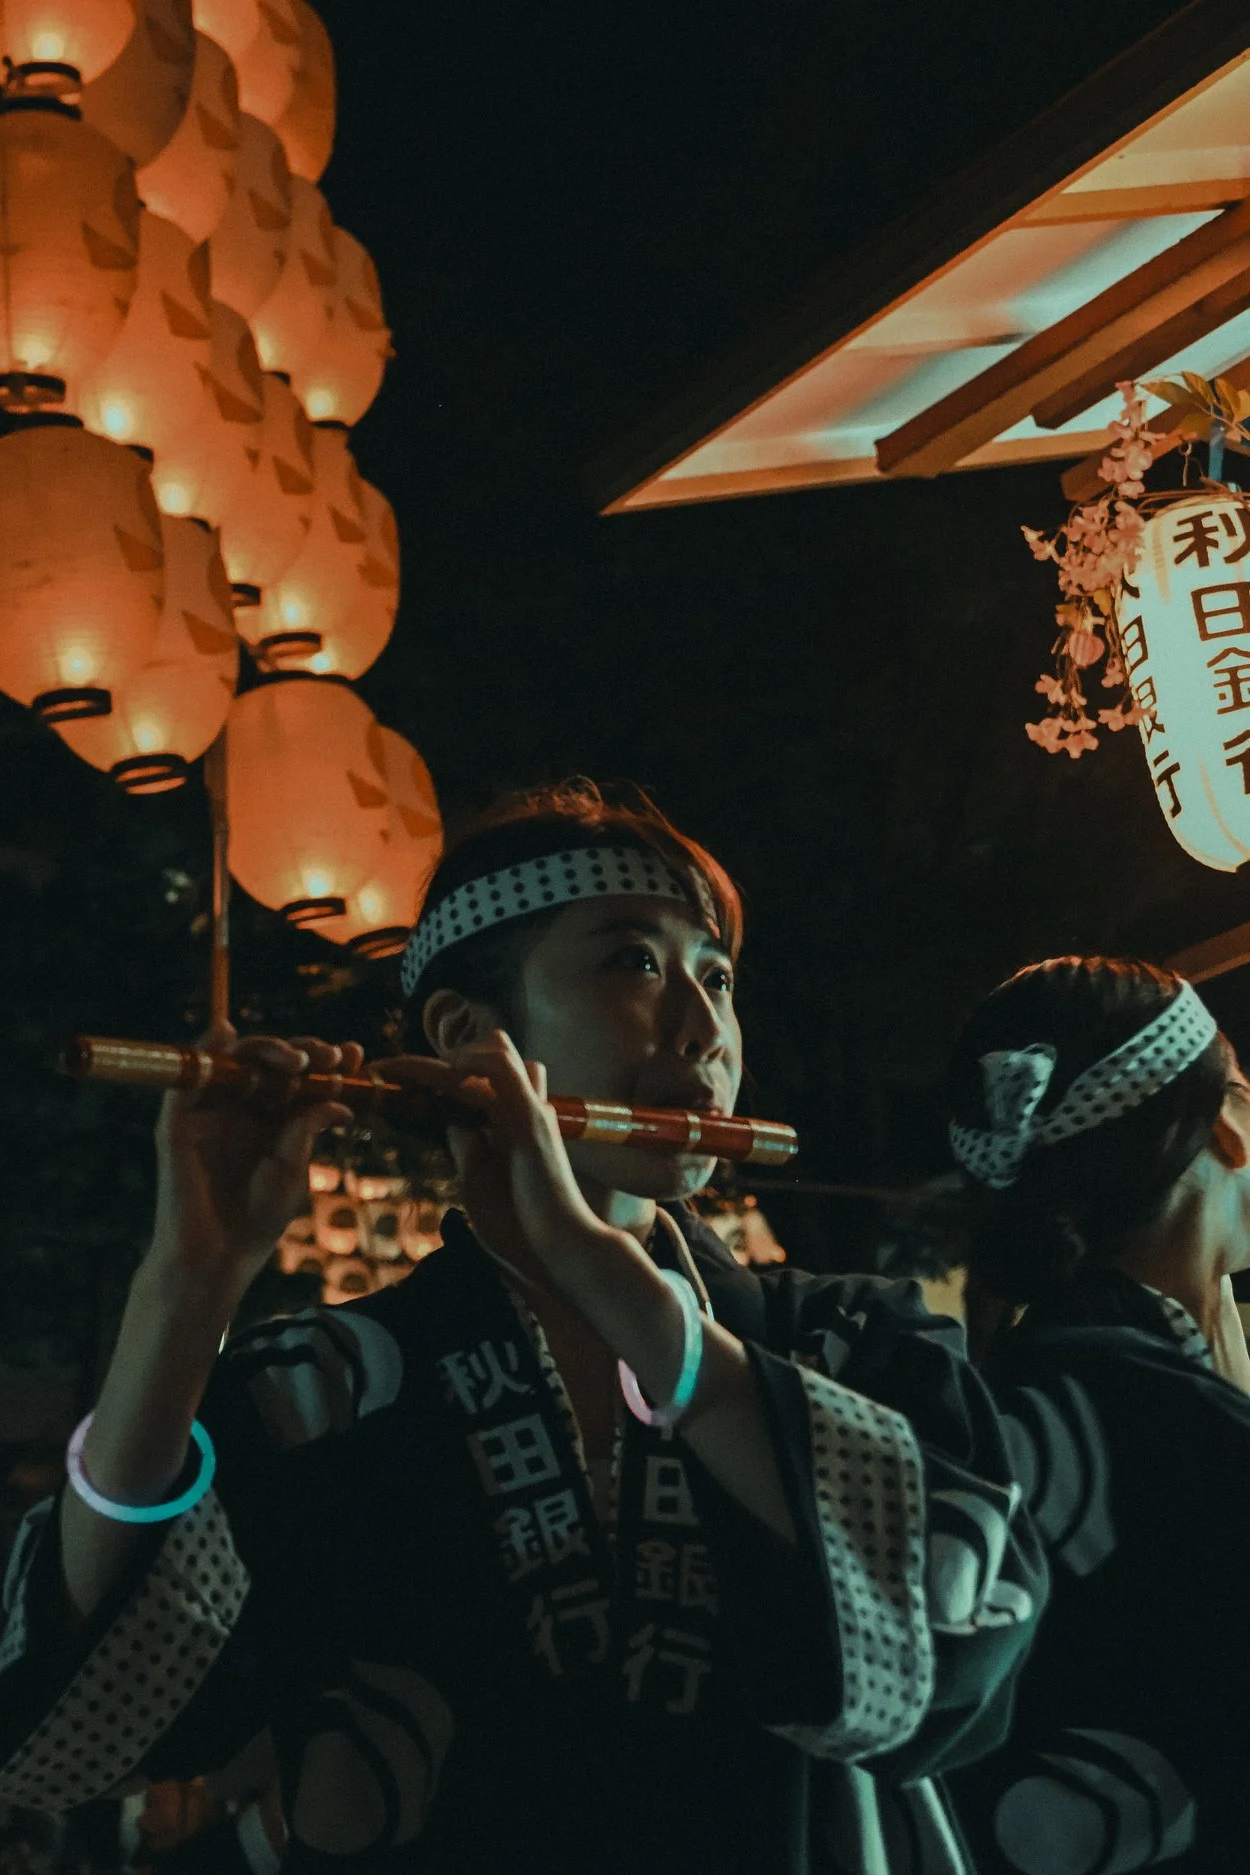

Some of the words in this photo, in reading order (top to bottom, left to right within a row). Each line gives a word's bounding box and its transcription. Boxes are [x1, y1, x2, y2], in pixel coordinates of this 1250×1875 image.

[437, 1339, 613, 1677] 秋田銀行
[621, 1427, 721, 1716] 田銀行
